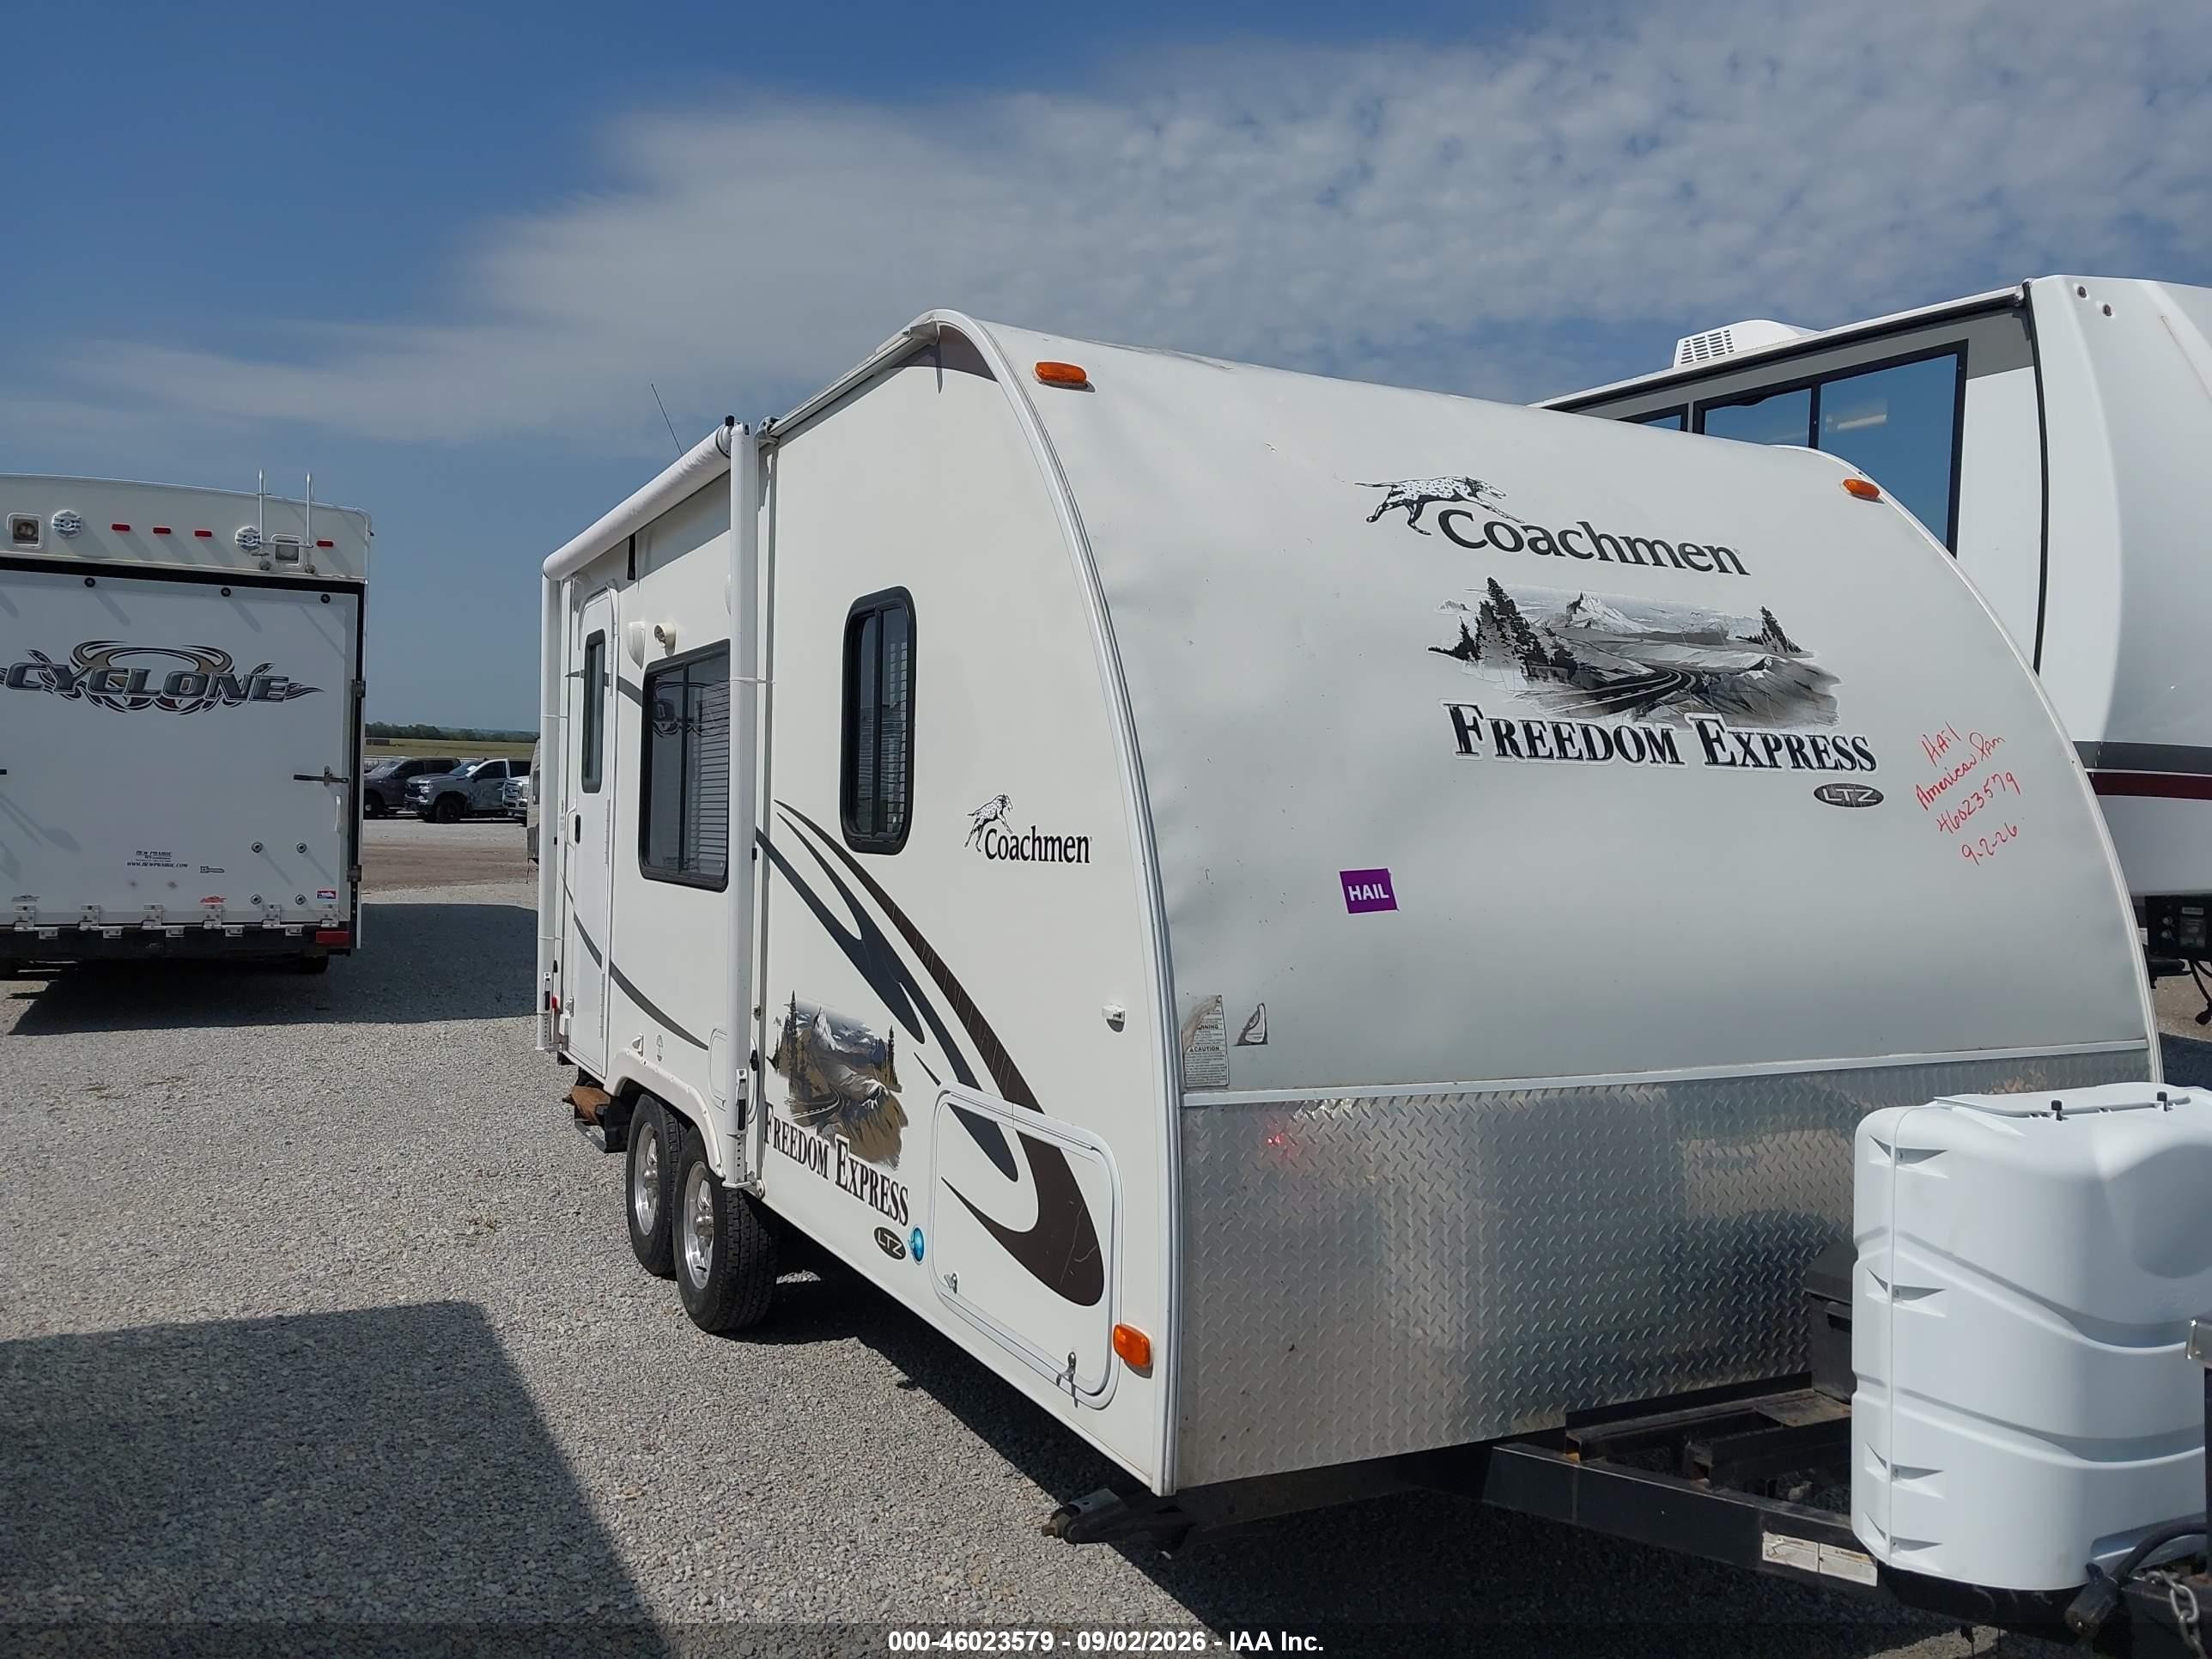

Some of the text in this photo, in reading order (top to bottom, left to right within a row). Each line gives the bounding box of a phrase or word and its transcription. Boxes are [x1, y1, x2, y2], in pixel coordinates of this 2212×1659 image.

[1437, 508, 1751, 576] Coachmen
[4, 661, 291, 703] CYCLONE
[1443, 702, 1879, 772] FREEDOM EXPRESS
[1822, 787, 1877, 802] LTZ
[1936, 771, 2021, 835] 46023579
[984, 824, 1091, 864] Coachmen
[1347, 883, 1389, 902] HAIL
[763, 1101, 909, 1227] FREEDOM EXPRESS
[877, 1229, 904, 1257] LTZ
